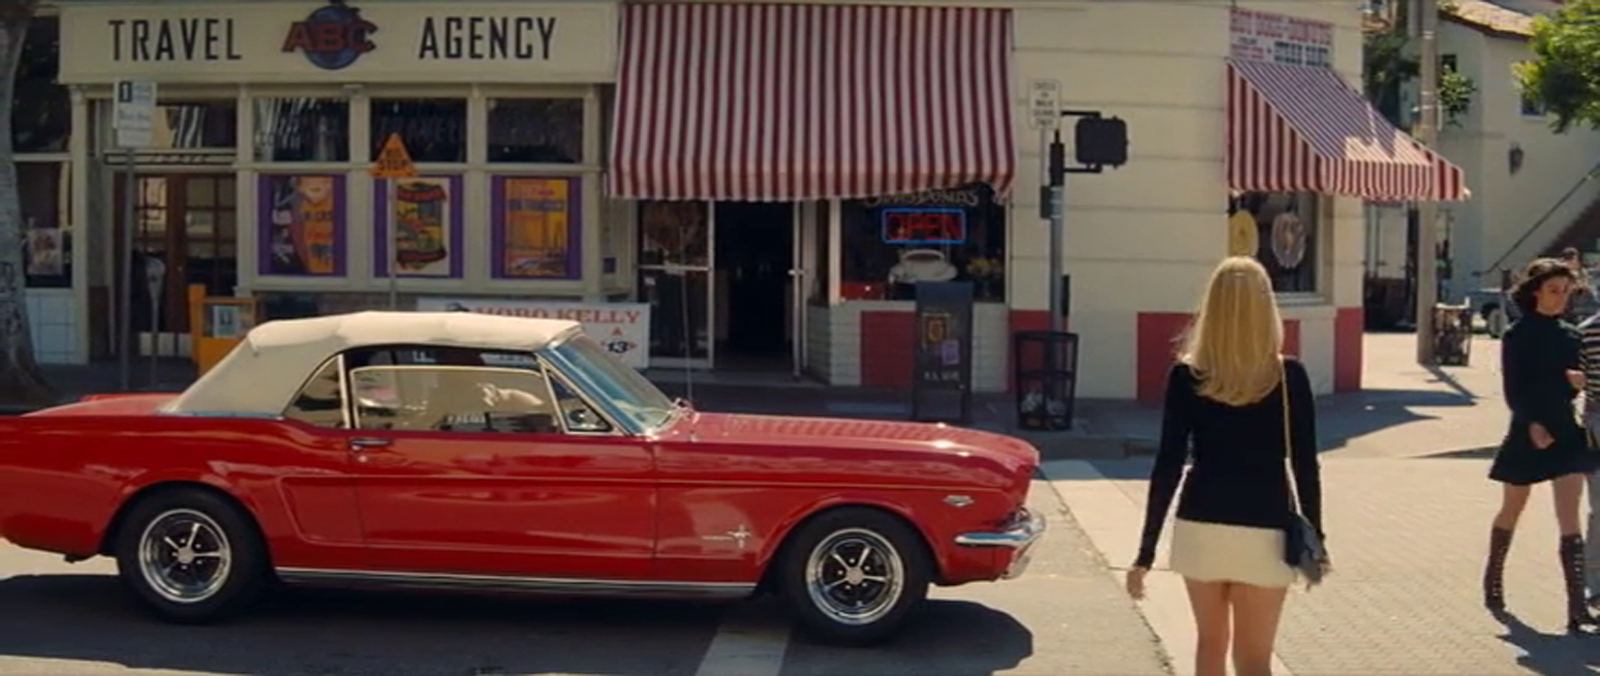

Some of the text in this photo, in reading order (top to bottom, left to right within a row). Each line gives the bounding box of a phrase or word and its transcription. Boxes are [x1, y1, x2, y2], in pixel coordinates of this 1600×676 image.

[109, 17, 556, 60] TRAVEL ABC AGENCY
[887, 212, 963, 239] OPEN
[558, 308, 640, 323] KELLY
